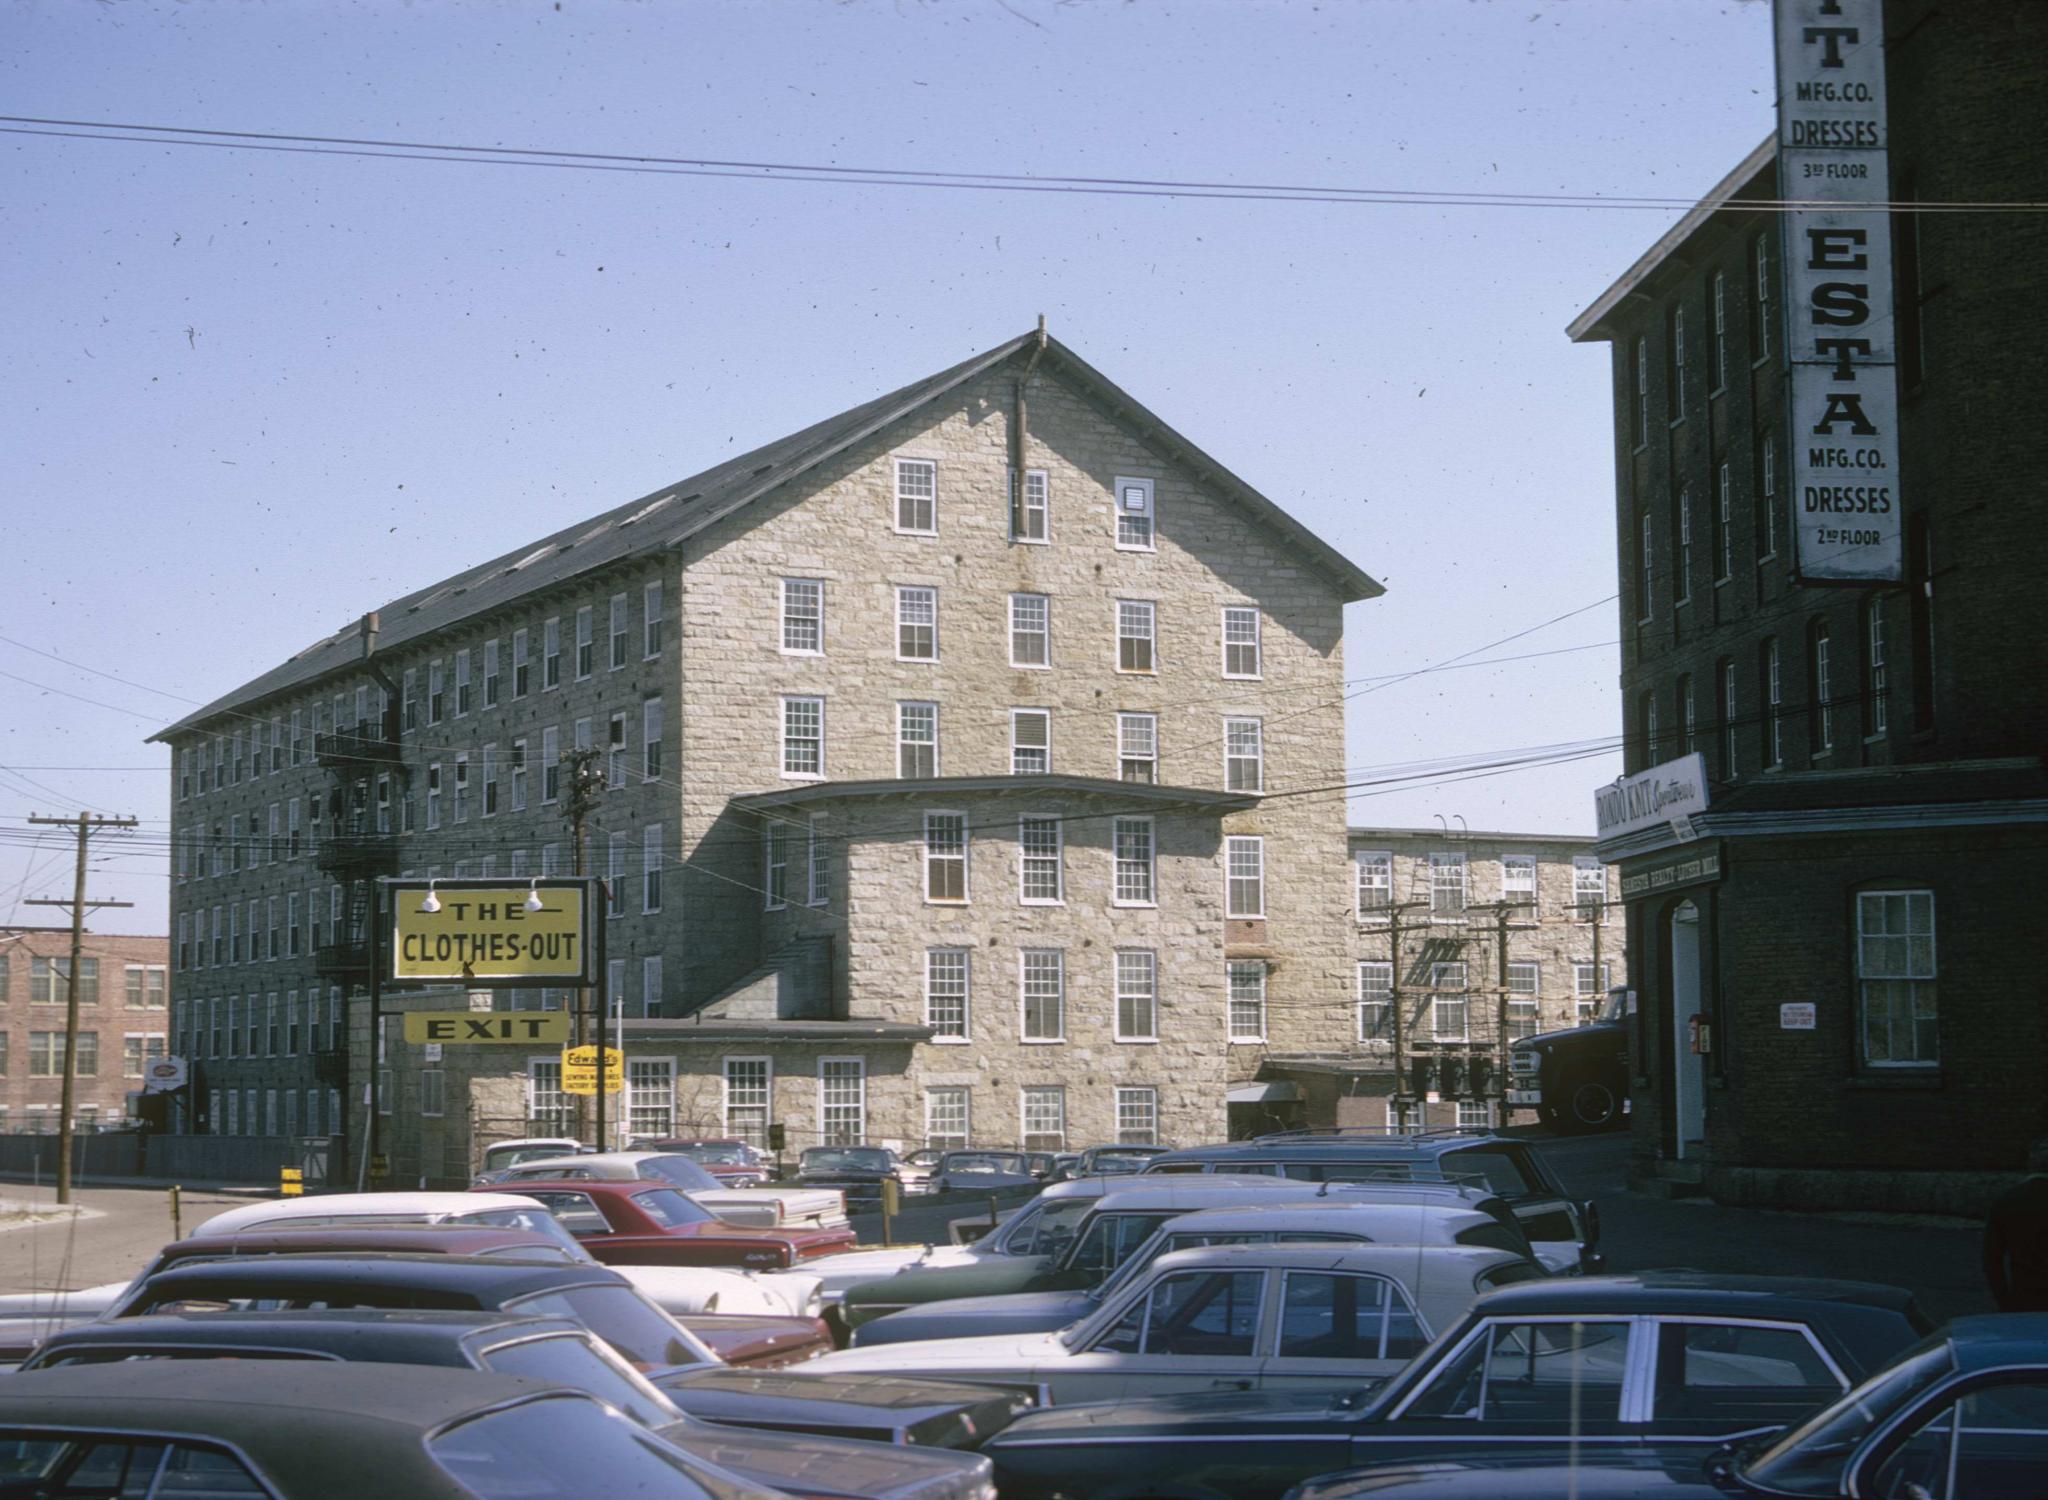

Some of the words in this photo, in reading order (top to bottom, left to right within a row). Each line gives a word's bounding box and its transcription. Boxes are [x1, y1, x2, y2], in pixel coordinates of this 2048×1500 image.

[1792, 120, 1878, 146] DRESSES
[1827, 163, 1868, 179] FLOOR
[1804, 486, 1891, 513] DRESSES
[1840, 529, 1881, 546] FLOOR
[1627, 778, 1654, 821] KNIT
[449, 902, 525, 921] THE
[403, 932, 577, 962] CLOTHES-OUT
[426, 1019, 550, 1039] EXIT
